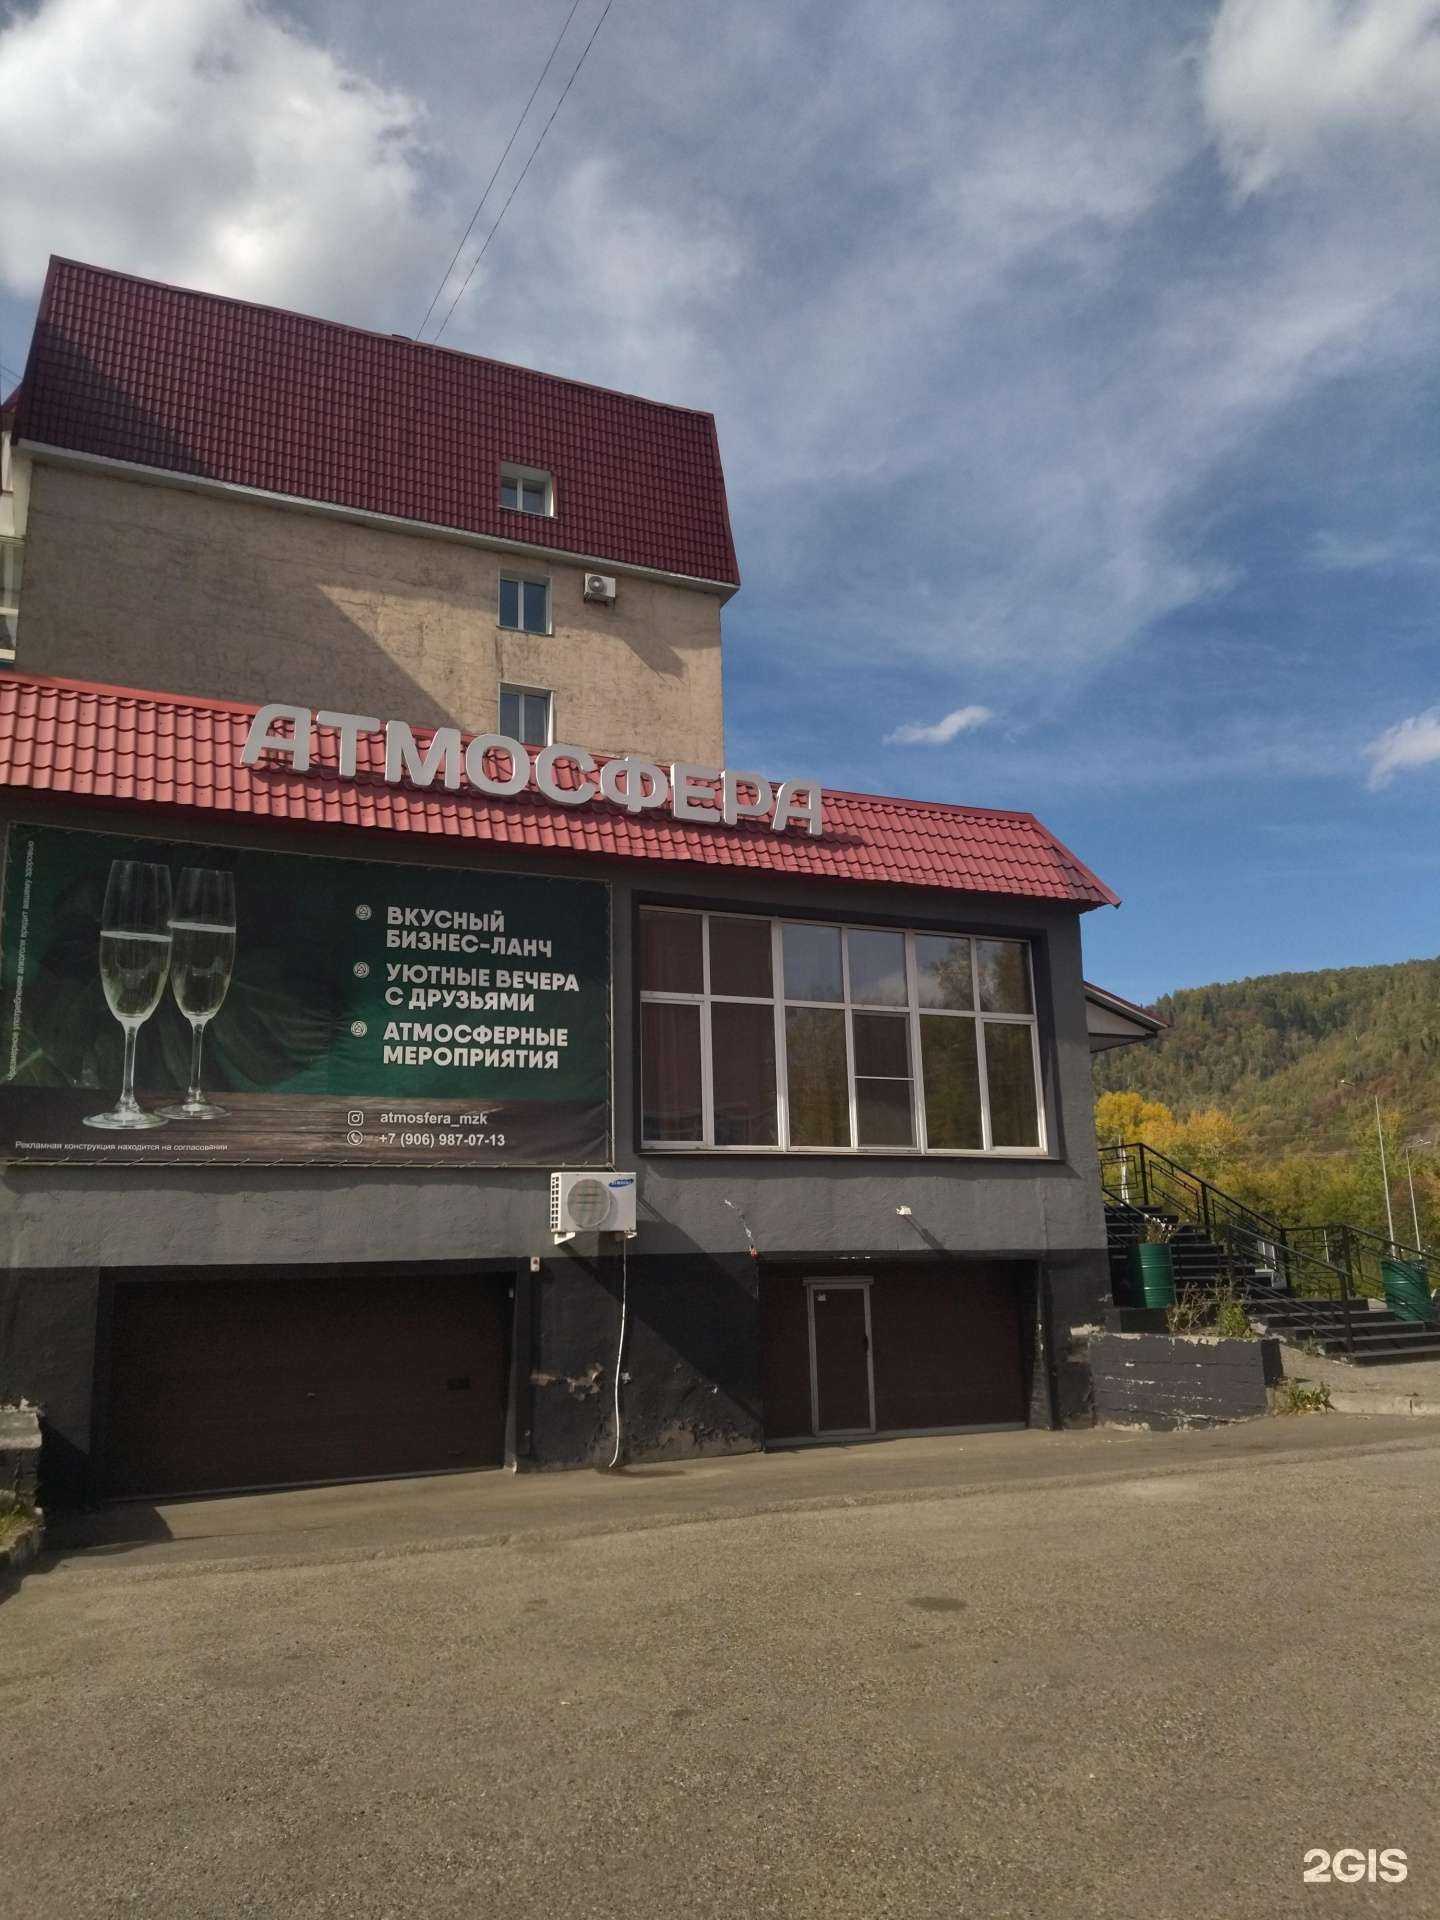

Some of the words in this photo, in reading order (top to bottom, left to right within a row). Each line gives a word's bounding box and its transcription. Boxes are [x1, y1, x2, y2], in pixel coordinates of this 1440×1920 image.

[240, 703, 824, 836] АТМОСФЕРА
[387, 906, 505, 933] ВКУСНЫЙ
[386, 929, 552, 958] БИЗНЕС-ЛАНЧ
[386, 963, 491, 986] УЮТНЫЕ
[496, 970, 580, 992] ВЕЧЕРА
[384, 986, 404, 1006] С
[408, 988, 535, 1012] ДРУЗЬЯМИ
[383, 1022, 569, 1047] АТМОСФЕРНЫЕ
[383, 1045, 559, 1069] МЕРОПРИЯТИЯ
[380, 1111, 488, 1128] atmosfera_mzk
[14, 1140, 62, 1150] Рекламная
[64, 1142, 116, 1152] конструкция
[117, 1143, 160, 1152] находится
[378, 1132, 396, 1145] +7
[400, 1132, 435, 1148] (906)
[438, 1133, 506, 1147] 987-07-13
